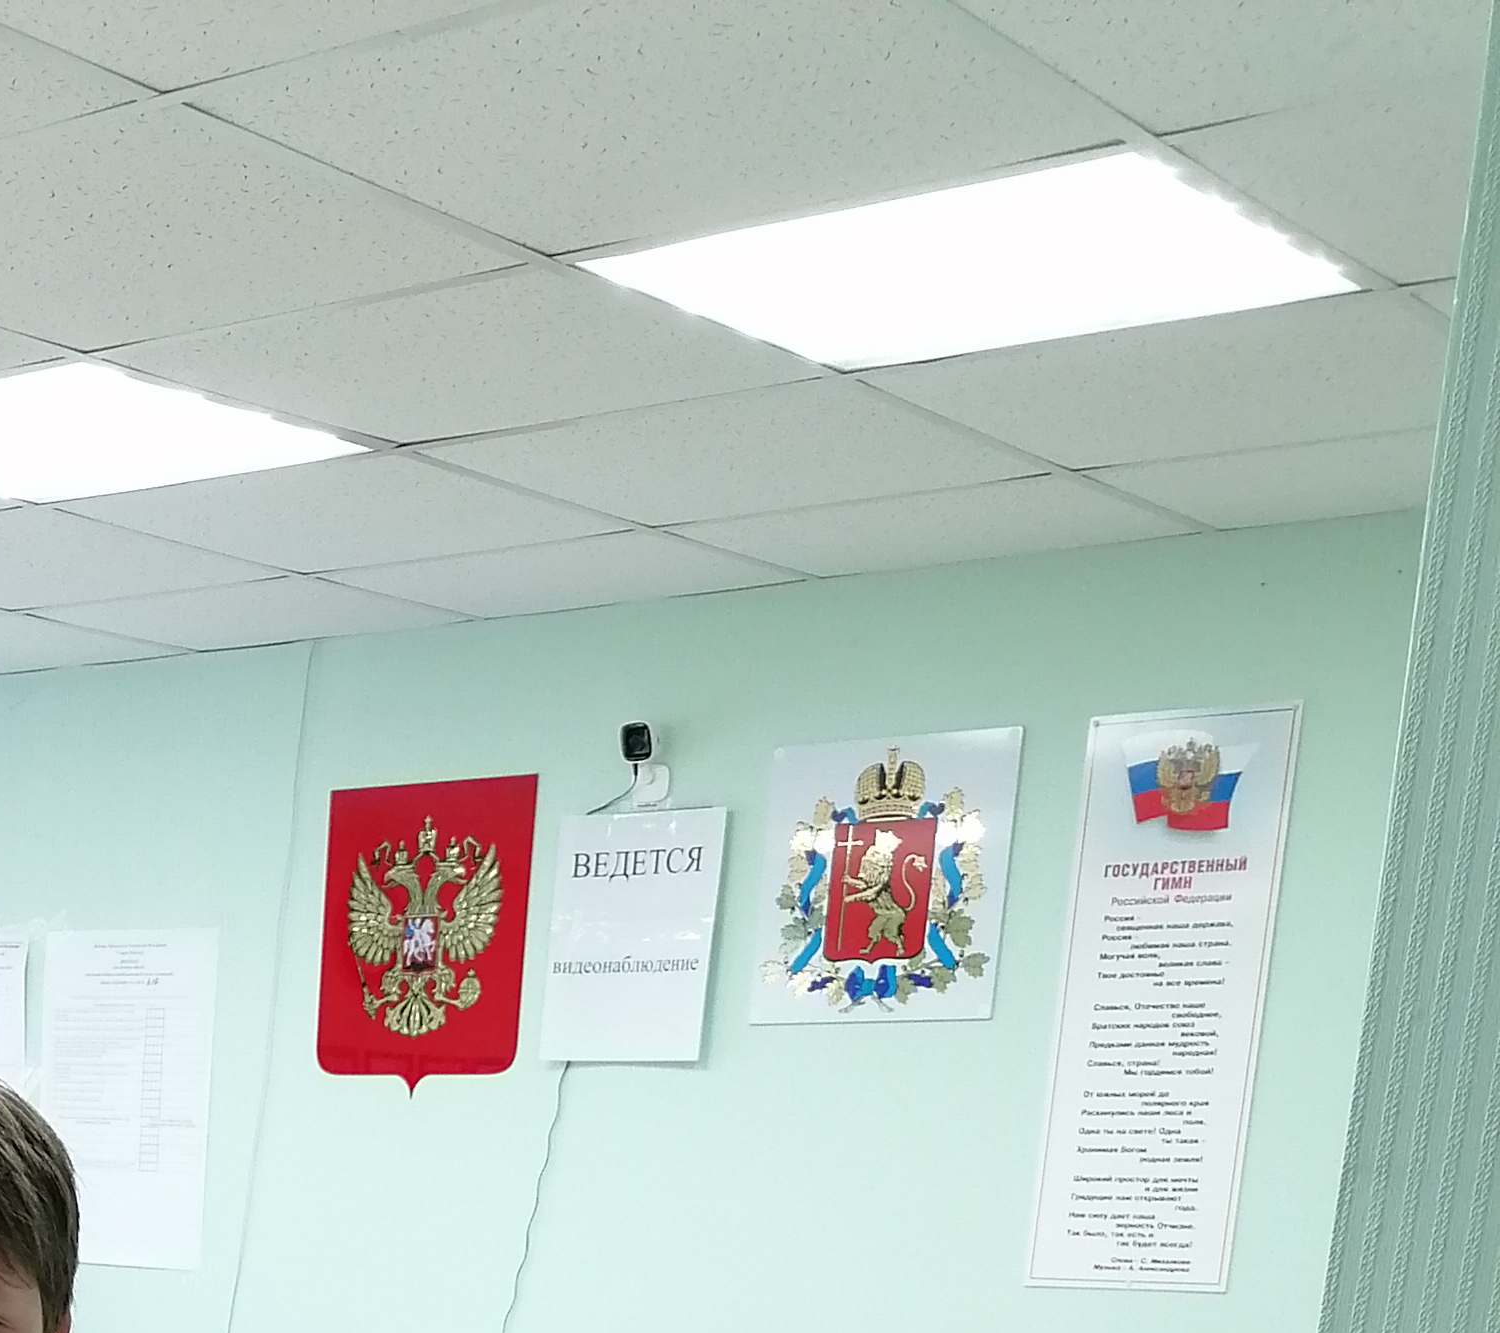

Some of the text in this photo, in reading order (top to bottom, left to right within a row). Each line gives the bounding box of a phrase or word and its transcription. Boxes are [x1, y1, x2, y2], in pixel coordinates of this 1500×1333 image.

[572, 846, 704, 882] ВЕДЕТСЯ
[1104, 856, 1248, 878] ГОСУДАРСТВЕННЫЙ
[1154, 876, 1192, 890] ГИМН
[1111, 895, 1232, 906] Российской Федерации
[552, 955, 699, 976] видеонаблюдение
